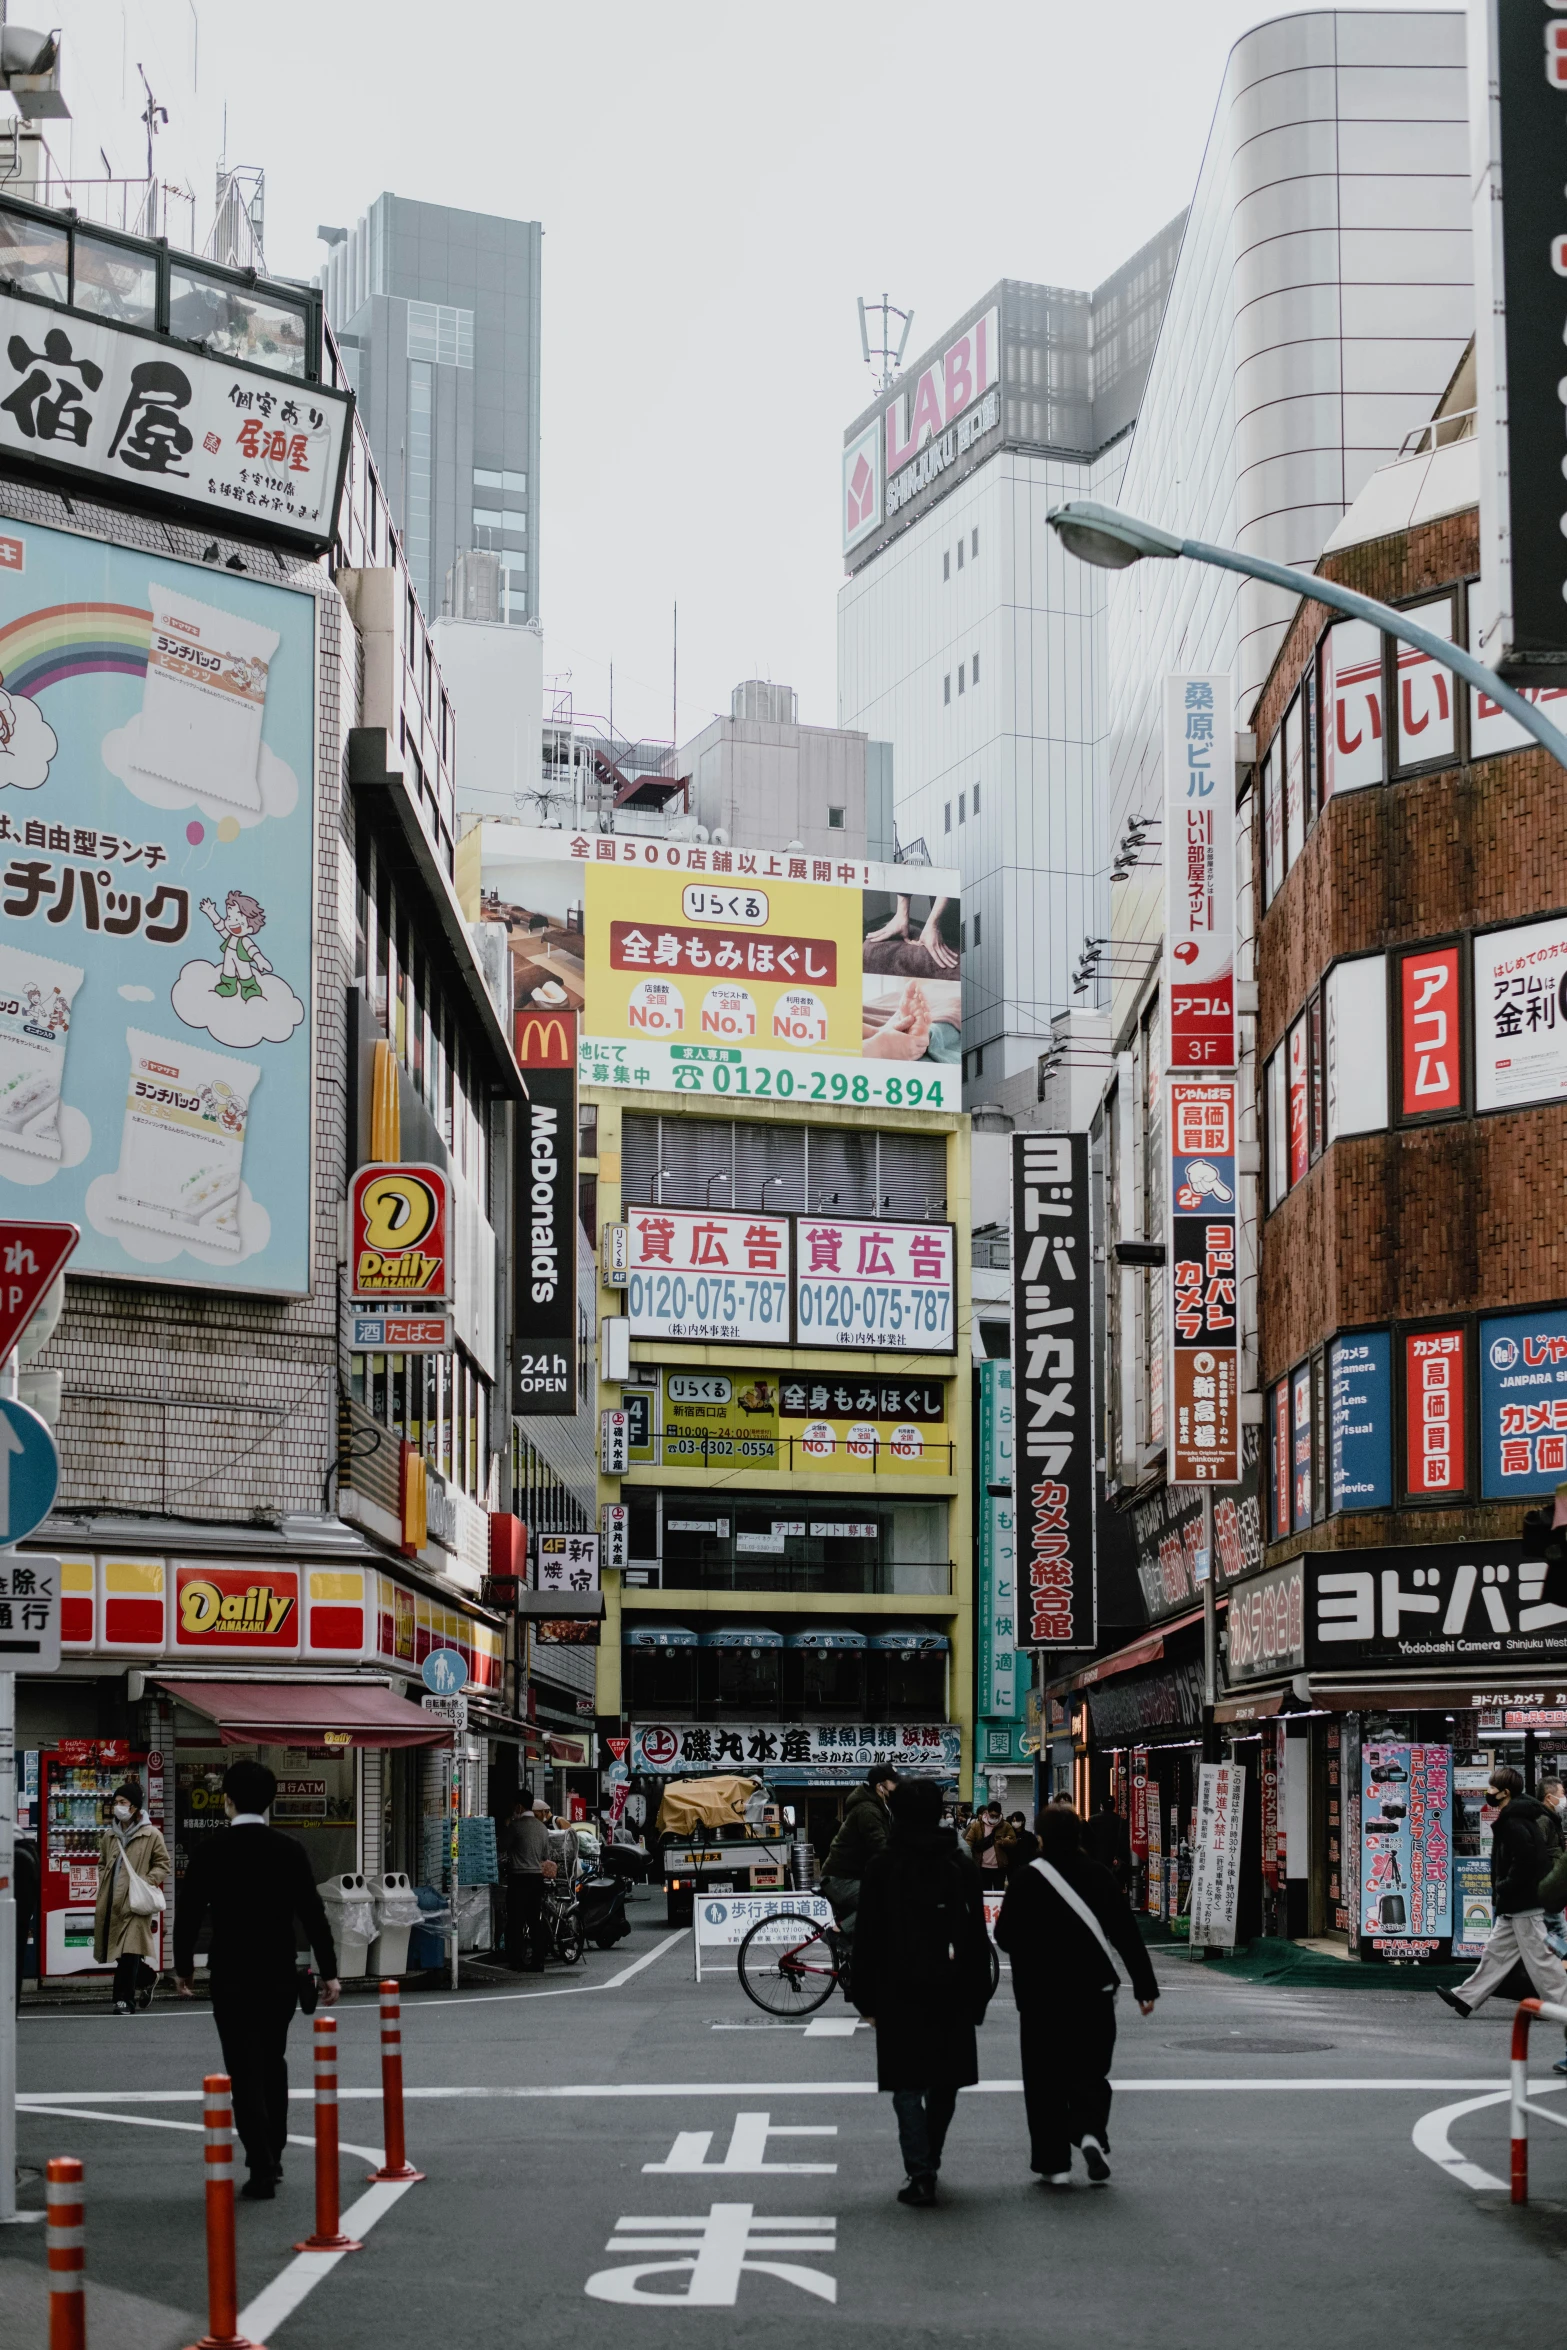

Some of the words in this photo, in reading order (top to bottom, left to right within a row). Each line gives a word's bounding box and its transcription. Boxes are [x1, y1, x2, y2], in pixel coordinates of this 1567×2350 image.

[1, 328, 194, 479] 宿屋
[227, 383, 324, 431] 個室あり
[885, 315, 987, 479] LABI
[235, 418, 311, 473] 居酒屋
[886, 430, 956, 517] SHINJUKU
[170, 617, 199, 636] ヤマザキ
[156, 636, 222, 672] ランチパック
[160, 654, 211, 682] ピーナッツ
[1183, 681, 1215, 799] 桑原ビル
[569, 836, 871, 885] 全国500店舗以上展開中!
[1187, 808, 1205, 932] いい部屋ネット
[1207, 847, 1215, 895] お部屋さがしは
[3, 861, 190, 944] チパック
[690, 892, 762, 919] りらくる
[620, 929, 828, 979] 全身もみほぐし
[643, 983, 670, 995] 店舗数
[711, 989, 749, 1001] セラピスト数
[1493, 975, 1556, 1001] アコムは
[645, 994, 667, 1006] 全国
[719, 998, 741, 1012] 全国
[786, 995, 814, 1006] 利用者数
[789, 1004, 811, 1017] 全国
[1173, 998, 1231, 1017] アコム
[628, 1006, 684, 1031] No.1
[701, 1010, 756, 1036] No.1
[1493, 993, 1556, 1039] 金利
[773, 1016, 827, 1041] No.1
[1412, 964, 1450, 1096] アコム
[682, 1047, 730, 1063] 求人専用
[1188, 1040, 1217, 1060] 3F
[149, 1062, 178, 1077] ヤマザキ
[135, 1081, 200, 1112] ランチパック
[712, 1064, 945, 1108] 0120-298-894
[1173, 1087, 1232, 1101] じゃんぱら
[136, 1099, 172, 1120] たまご
[1182, 1105, 1224, 1127] 高価
[1182, 1128, 1224, 1150] 買取
[531, 1103, 559, 1304] McDonald's
[1178, 1186, 1201, 1207] 2F
[636, 1217, 783, 1271] 貸広告
[805, 1227, 947, 1280] 貸広告
[359, 1252, 441, 1287] Daily
[612, 1272, 626, 1282] 4F
[1205, 1224, 1234, 1332] ヨドバシ
[359, 1276, 417, 1289] YAMAZAKI
[629, 1274, 787, 1325] 0120-075-787
[800, 1283, 951, 1333] 0120-075-787
[1021, 1137, 1076, 1477] ヨドバシカメラ
[1174, 1259, 1203, 1339] カメラ
[358, 1322, 381, 1342] 酒
[387, 1322, 443, 1342] たばこ
[668, 1323, 741, 1338] (株)内外事業社
[836, 1331, 907, 1347] (株)内外事業社
[1413, 1335, 1460, 1357] カメラ!
[520, 1378, 567, 1393] OPEN
[674, 1380, 726, 1398] りらくる
[1500, 1372, 1552, 1388] JANPARA
[784, 1383, 941, 1415] 全身もみほぐし
[672, 1405, 728, 1419] 新宿西口店
[1425, 1360, 1448, 1484] 高価買取
[802, 1439, 836, 1453] No.1
[1187, 1456, 1226, 1464] shinkouyo
[543, 1539, 566, 1553] 4F
[1029, 1480, 1074, 1641] カメラ総合館
[180, 1580, 294, 1634] Daily
[214, 1620, 266, 1633] YAMAZAKI
[1398, 1641, 1455, 1655] Yodobashi
[1456, 1639, 1501, 1652] Camera
[1506, 1639, 1543, 1651] Shinjuku
[1471, 1693, 1545, 1706] ヨドバシカメラ
[323, 1731, 353, 1745] Daily
[680, 1728, 812, 1763] 磯丸水産
[817, 1726, 897, 1747] 鮮魚貝類
[991, 1734, 1008, 1752] 薬
[276, 1782, 325, 1794] 銀行ATM
[1426, 1747, 1448, 1881] 卒業式・入学式
[731, 1900, 828, 1919] 歩行者用道路
